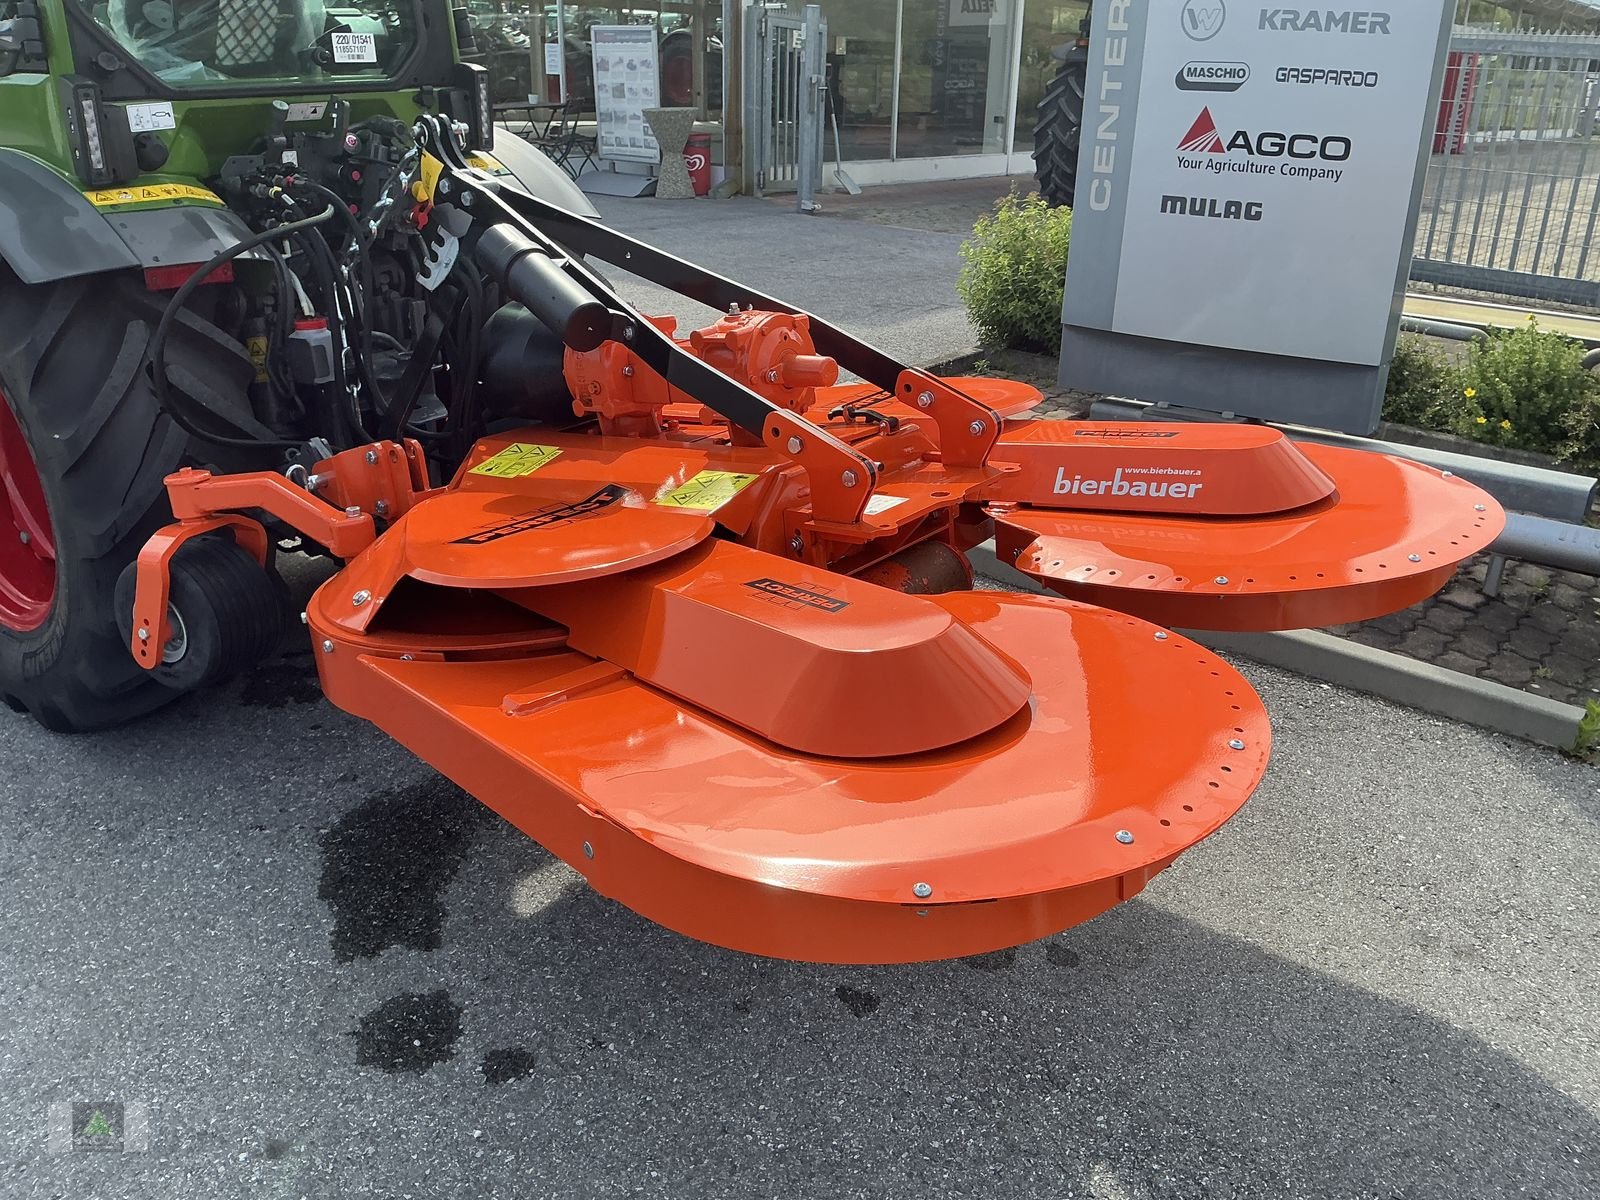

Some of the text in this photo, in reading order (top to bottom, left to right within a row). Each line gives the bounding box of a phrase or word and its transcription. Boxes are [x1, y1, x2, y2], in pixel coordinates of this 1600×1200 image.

[1258, 8, 1392, 35] KRAMER
[1186, 66, 1247, 80] MASCHIO
[1275, 66, 1379, 88] GASPARDO
[1090, 0, 1132, 212] CENTER
[1226, 130, 1352, 162] AGCO
[1177, 156, 1343, 183] Your Agriculture Company
[1053, 466, 1203, 499] bierbauer
[468, 492, 614, 542] PERFECT
[754, 581, 841, 609] PERFECT
